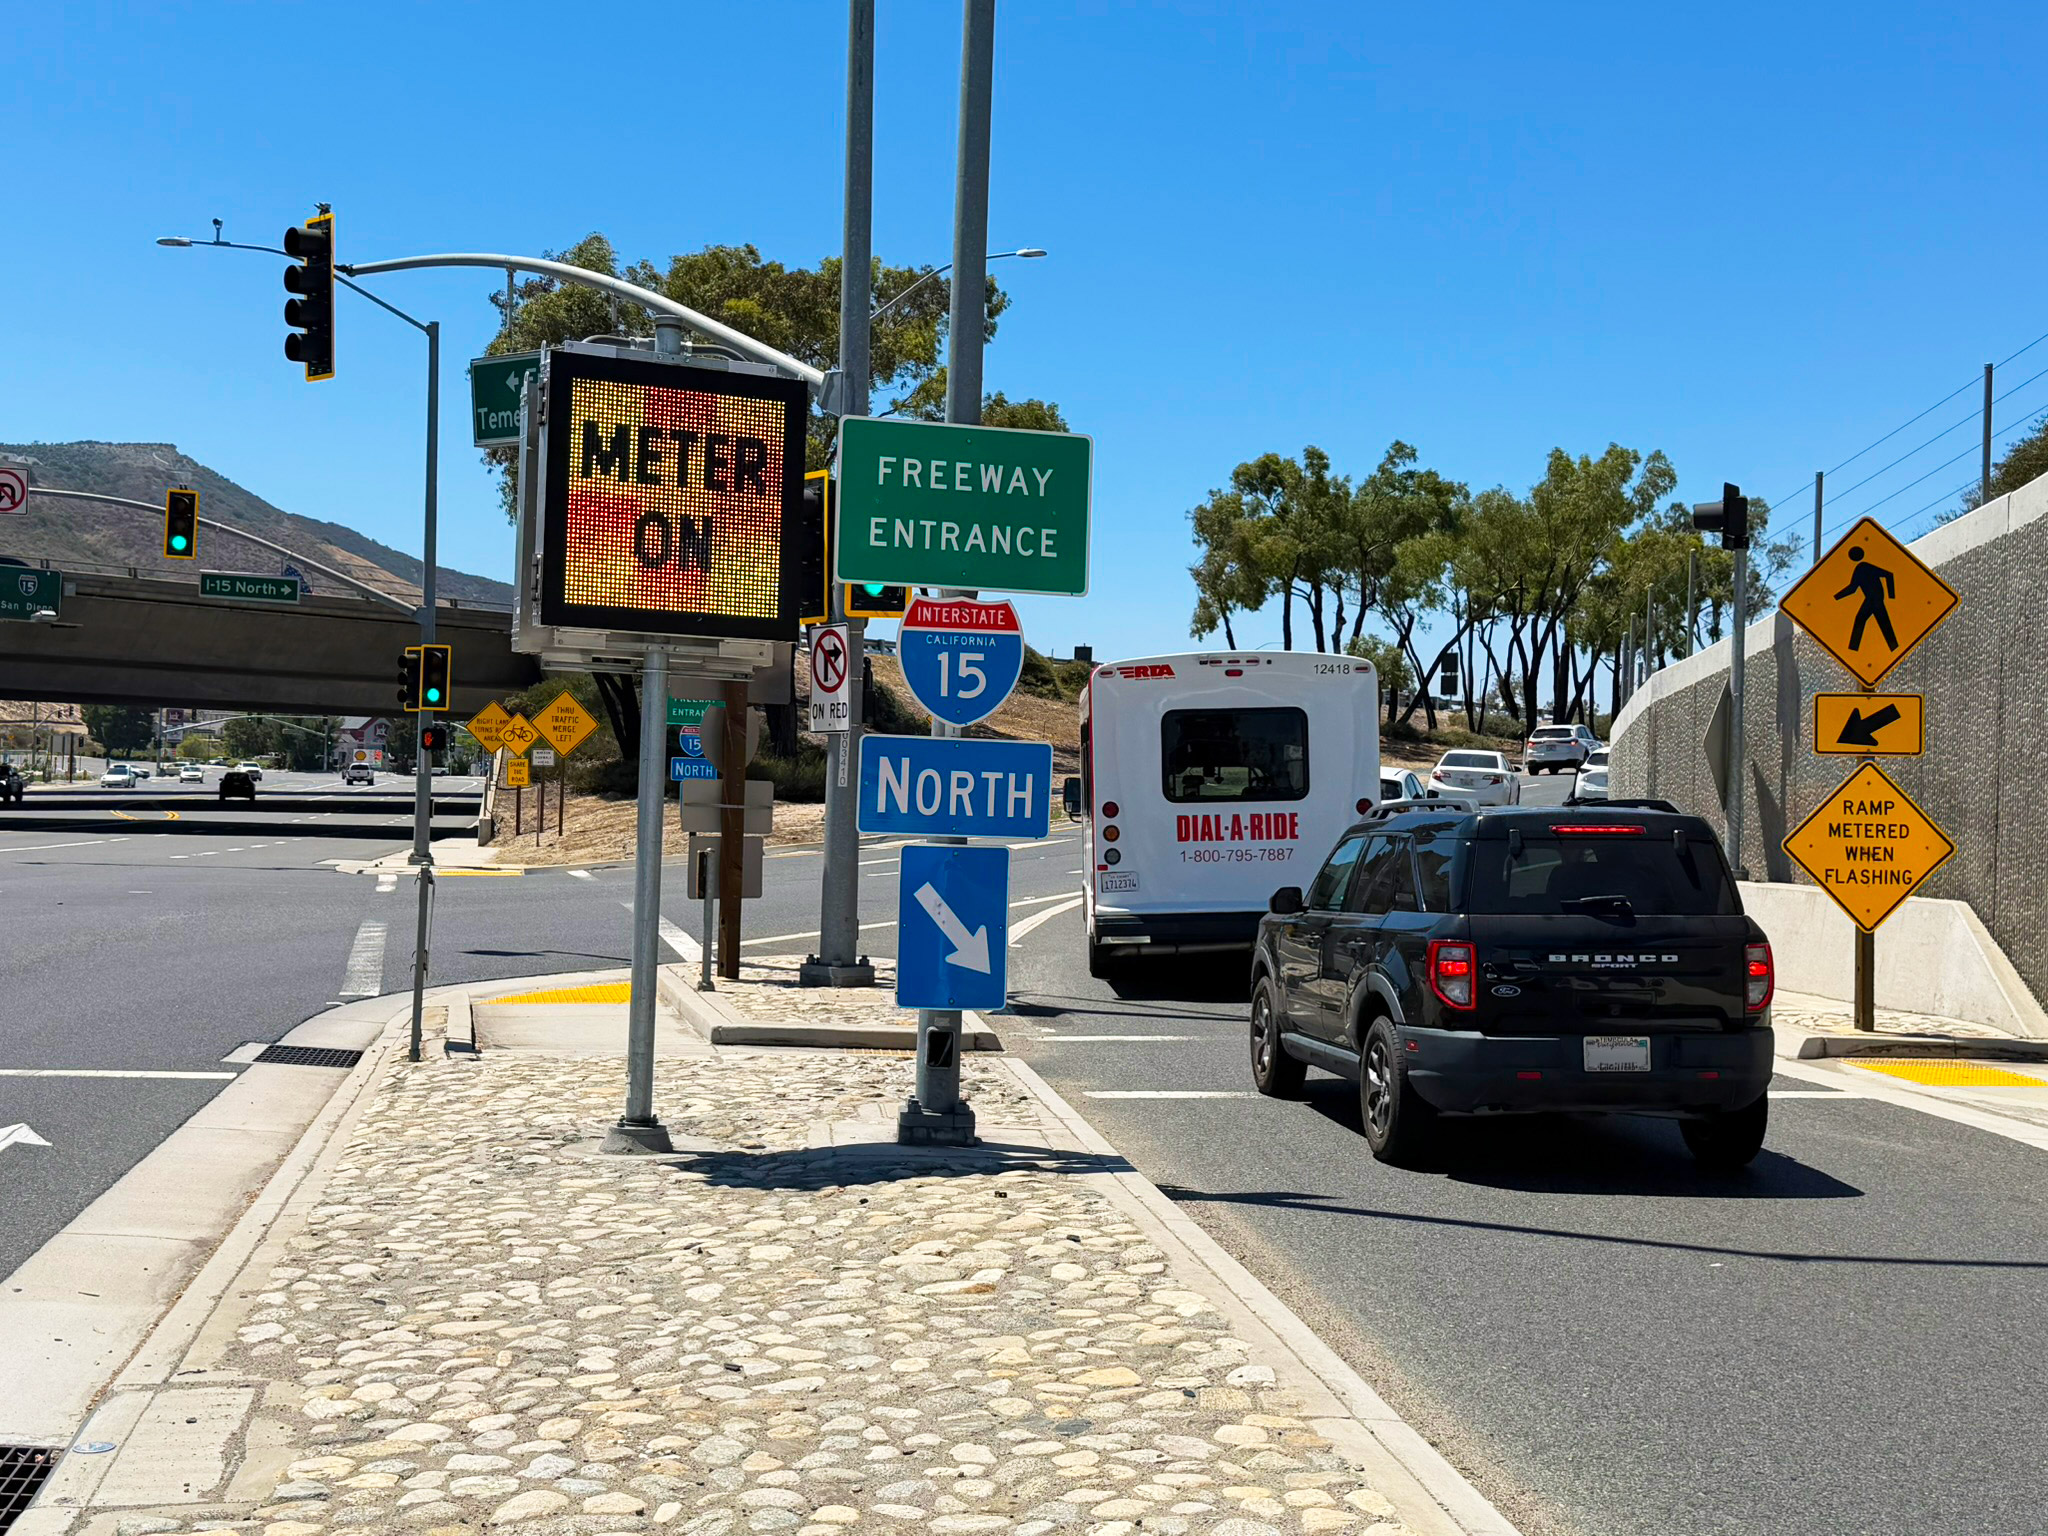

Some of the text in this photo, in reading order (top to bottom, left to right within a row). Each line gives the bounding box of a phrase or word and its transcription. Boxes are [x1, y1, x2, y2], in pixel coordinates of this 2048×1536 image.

[477, 407, 520, 430] Teme
[581, 420, 768, 495] METER
[878, 456, 1053, 497] FREEWAY
[634, 511, 713, 571] ON
[869, 516, 1057, 558] ENTRANCE
[22, 581, 35, 592] 15
[206, 579, 276, 595] I-15 North
[1, 600, 19, 610] San
[918, 606, 1006, 625] INTERSTATE
[926, 634, 997, 647] CALIFORNIA
[937, 651, 987, 699] 15
[1135, 664, 1176, 677] RTA
[1313, 663, 1350, 675] 12418
[556, 706, 575, 714] THRU
[672, 708, 705, 717] ENTRAN
[812, 702, 848, 720] ON RED
[551, 715, 580, 724] TRAFFIC
[552, 725, 577, 733] MERGE
[555, 734, 572, 742] LEFT
[688, 738, 702, 751] 15
[675, 762, 713, 777] NORTH
[876, 756, 1033, 819] NORTH
[1843, 800, 1895, 816] RAMP
[1828, 822, 1910, 839] METERED
[1180, 847, 1294, 863] 1-800-795-7887
[1845, 846, 1894, 862] WHEN
[1825, 868, 1912, 885] FLASHING
[1548, 954, 1679, 963] BRONCO
